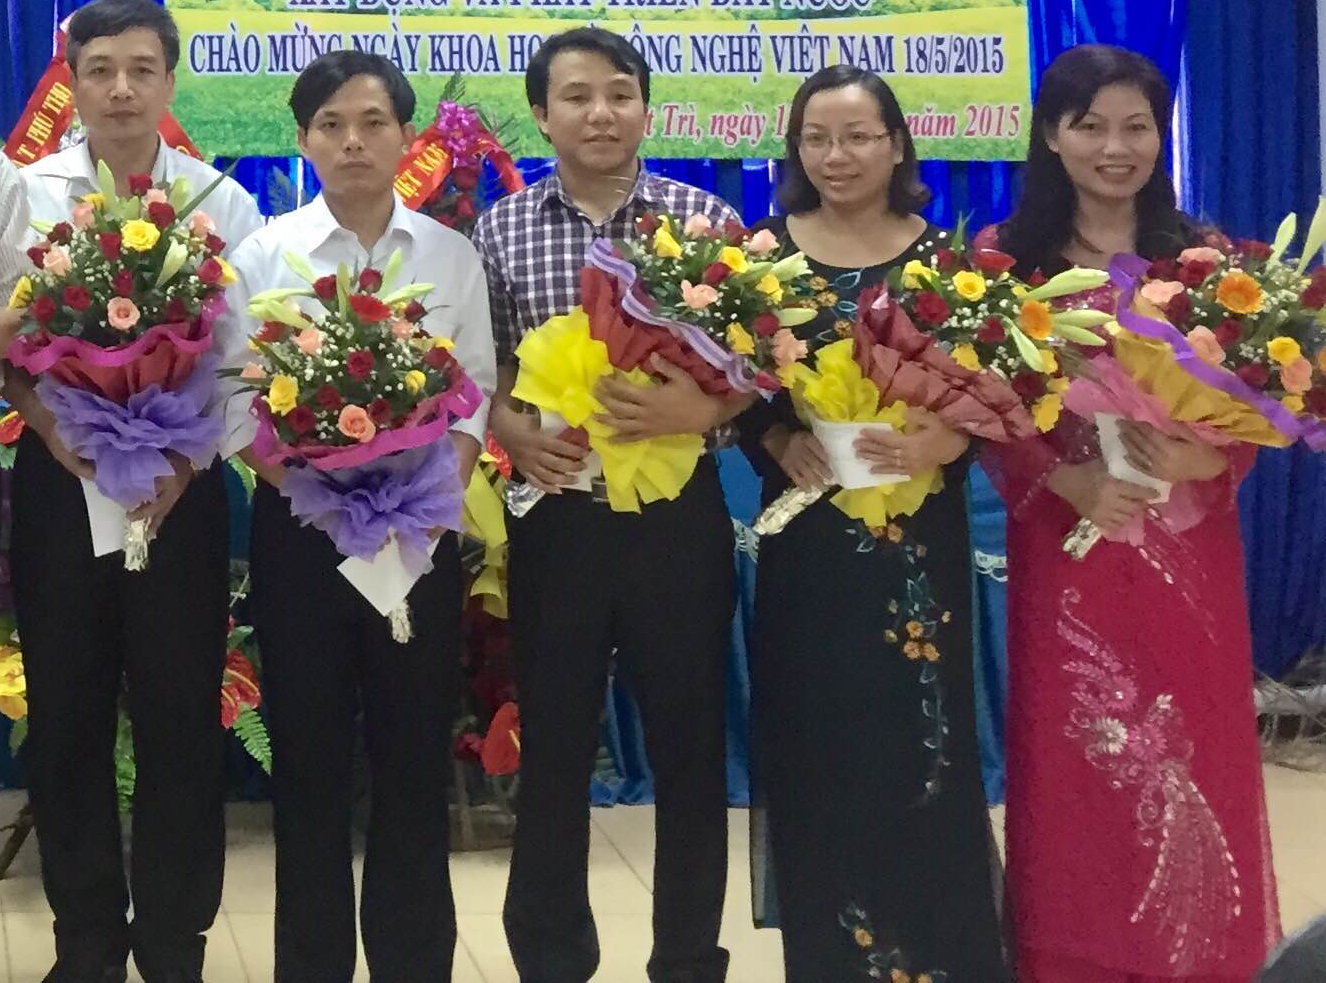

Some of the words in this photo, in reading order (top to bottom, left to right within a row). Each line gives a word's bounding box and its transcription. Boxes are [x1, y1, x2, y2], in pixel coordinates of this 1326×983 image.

[189, 23, 261, 73] CHÀO
[428, 34, 501, 73] KHOA
[622, 23, 683, 73] ÔNG
[690, 23, 763, 83] NGHỆ
[769, 23, 831, 83] VIỆT
[837, 35, 896, 73] NAM
[902, 35, 1004, 74] 18/5/2015
[26, 111, 55, 146] PHÚ
[42, 82, 73, 115] THỌ
[664, 104, 701, 142] Trì,
[710, 104, 766, 146] ngày
[906, 106, 956, 137] năm
[964, 104, 1020, 137] 2015
